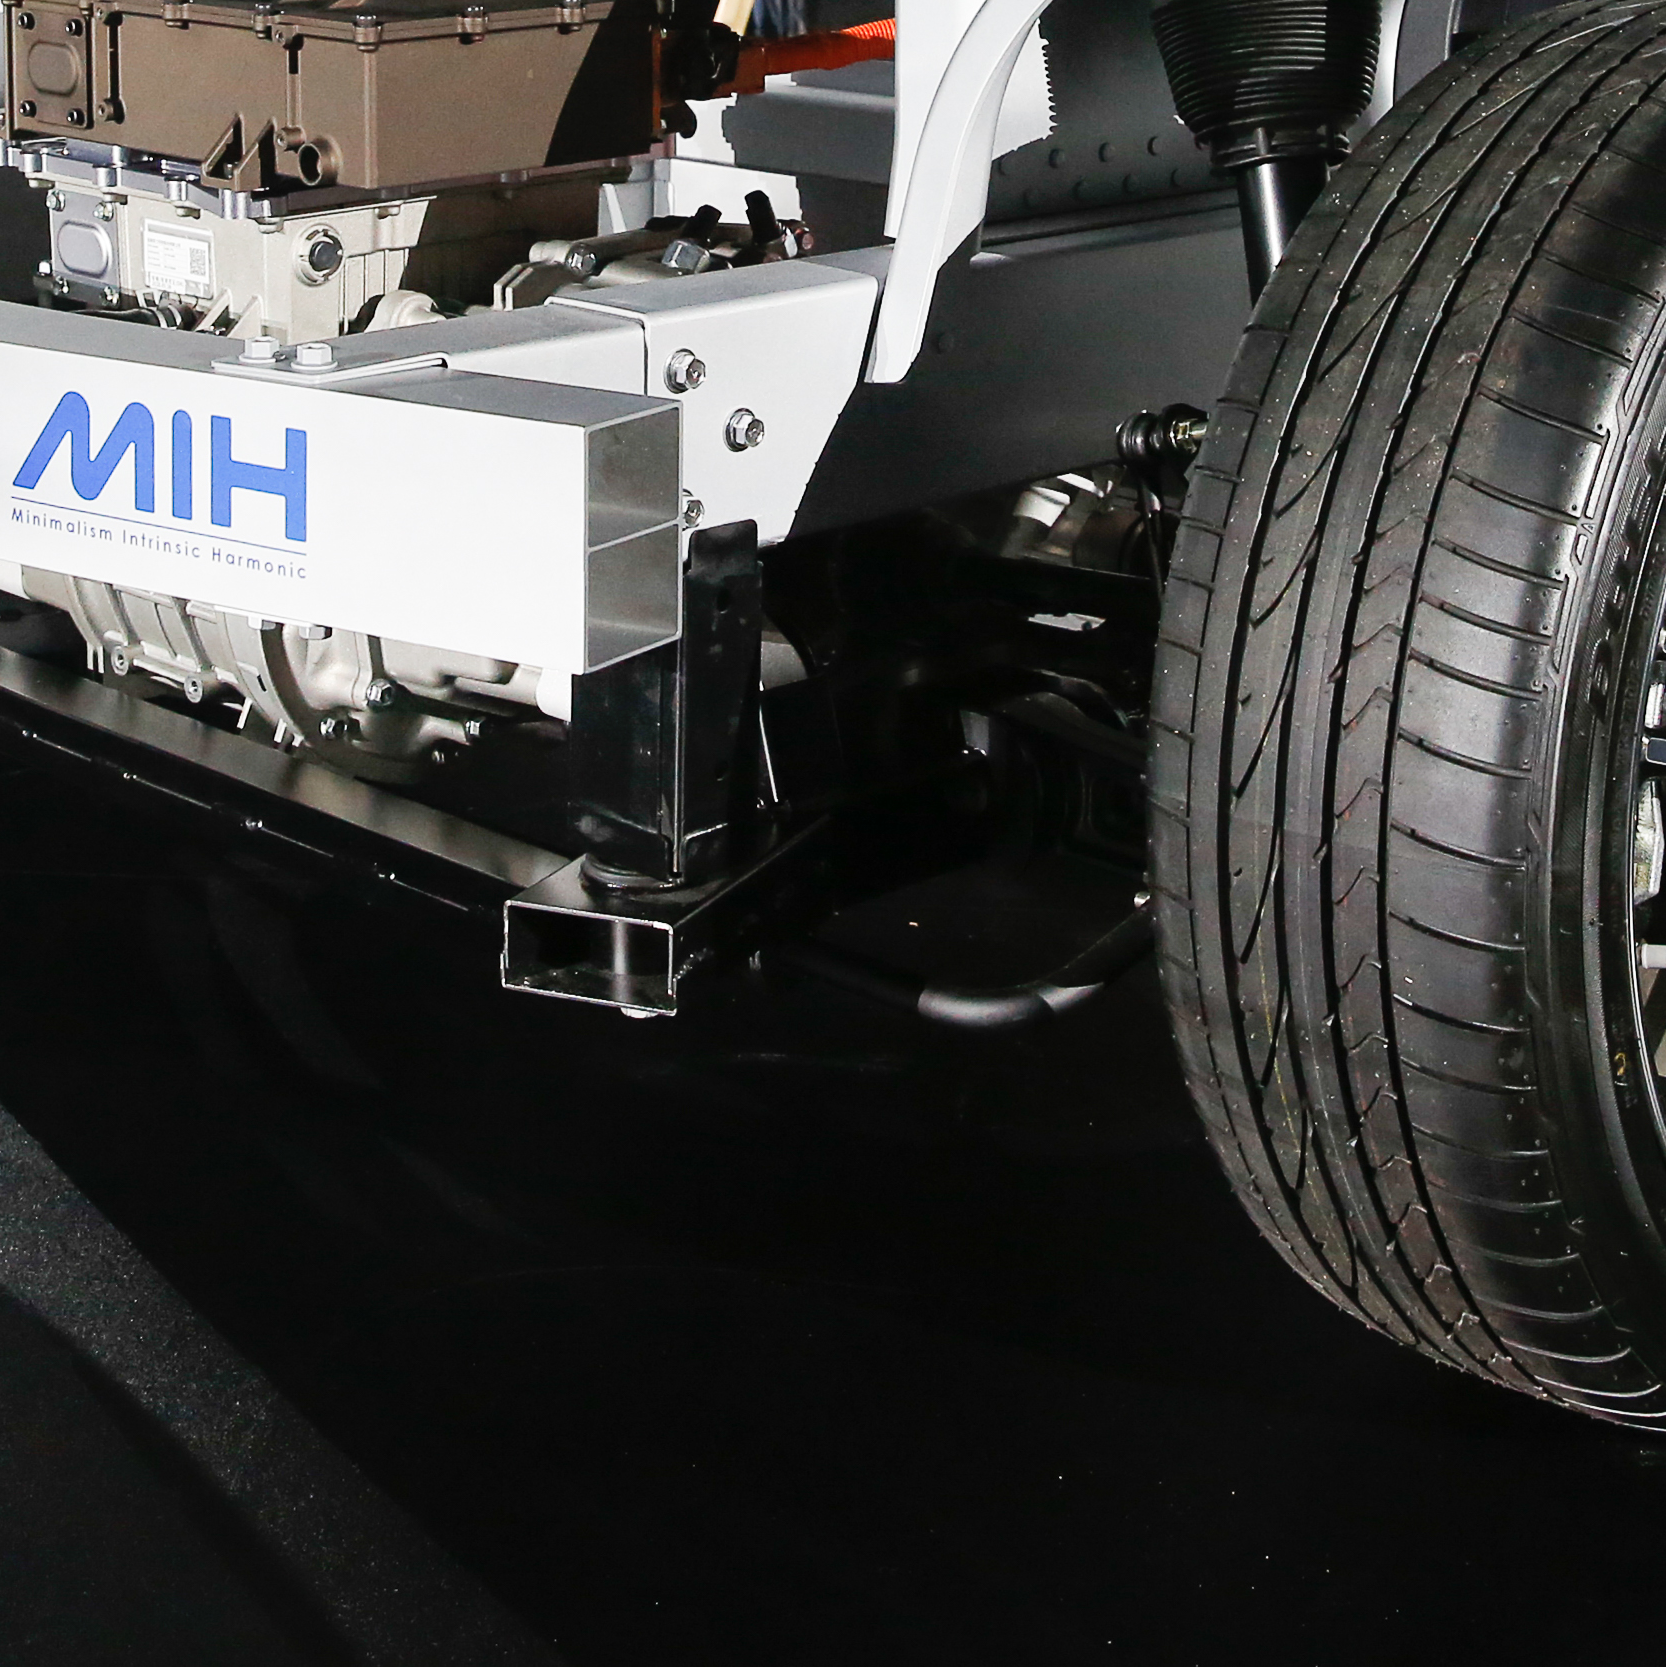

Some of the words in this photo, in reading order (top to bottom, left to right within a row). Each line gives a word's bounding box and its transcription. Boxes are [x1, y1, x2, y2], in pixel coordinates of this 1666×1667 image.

[12, 391, 307, 541] MIH
[11, 507, 113, 541] Minimalism
[123, 529, 201, 558] Intrinsic
[212, 547, 307, 579] Harmonic
